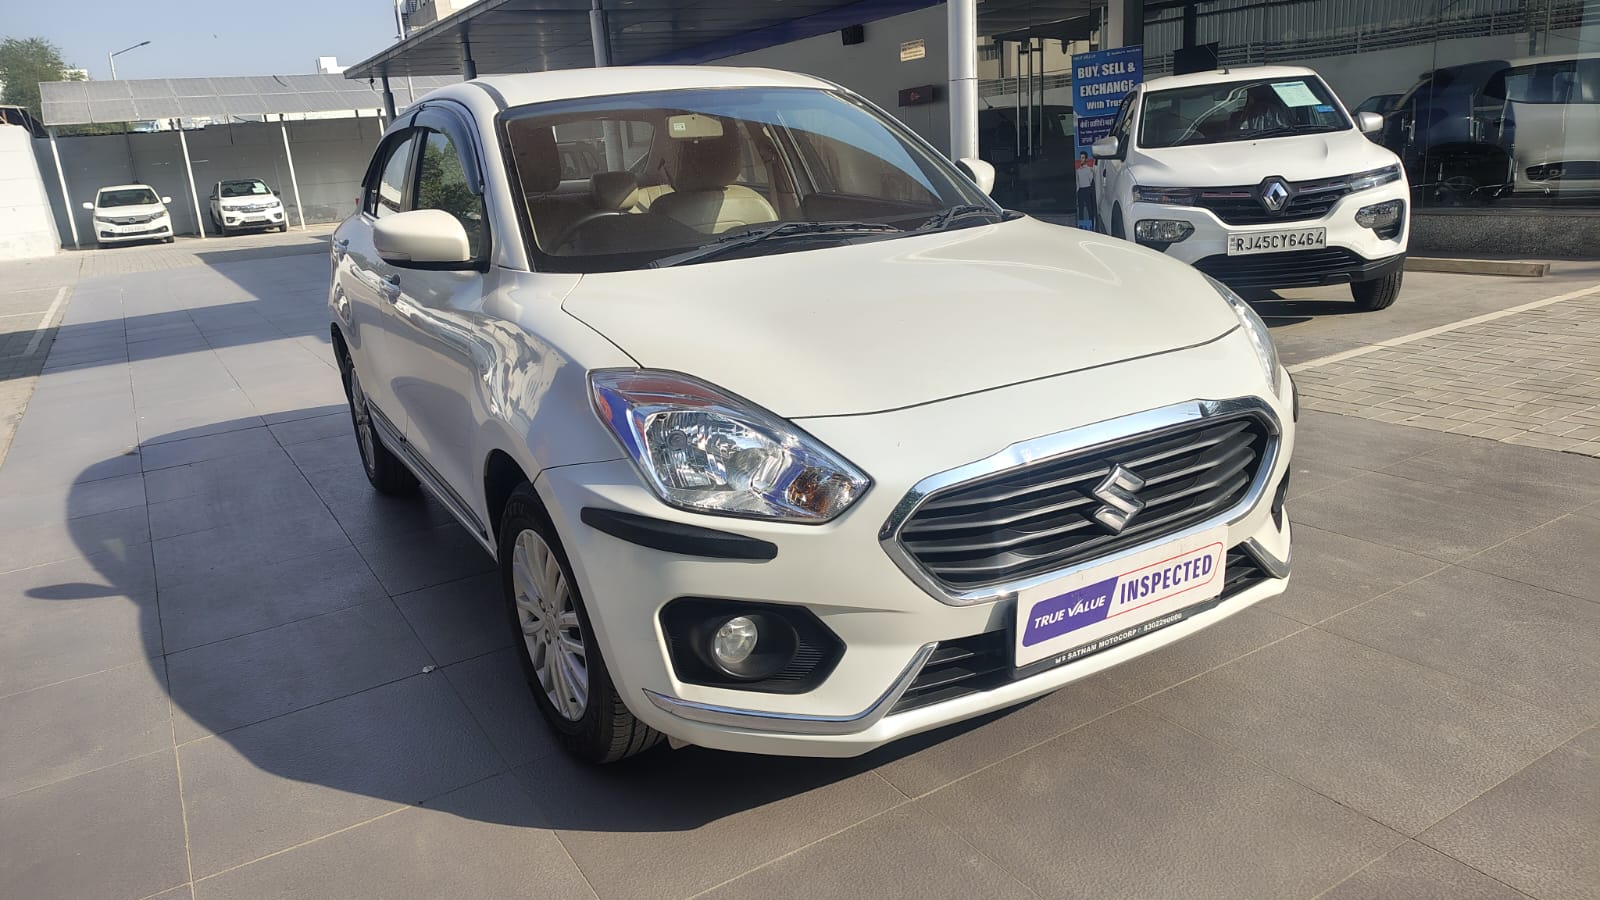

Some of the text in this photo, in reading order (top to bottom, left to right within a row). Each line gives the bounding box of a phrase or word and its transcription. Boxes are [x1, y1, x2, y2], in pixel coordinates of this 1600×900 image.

[1077, 61, 1136, 79] BUY, SELL &
[1080, 80, 1134, 97] EXCHANGE
[1086, 100, 1105, 110] With
[1236, 231, 1323, 251] RJ45CY6464
[1033, 554, 1213, 630] TRUE VALUE INSPECTED
[1098, 629, 1137, 649] MOTOCORP
